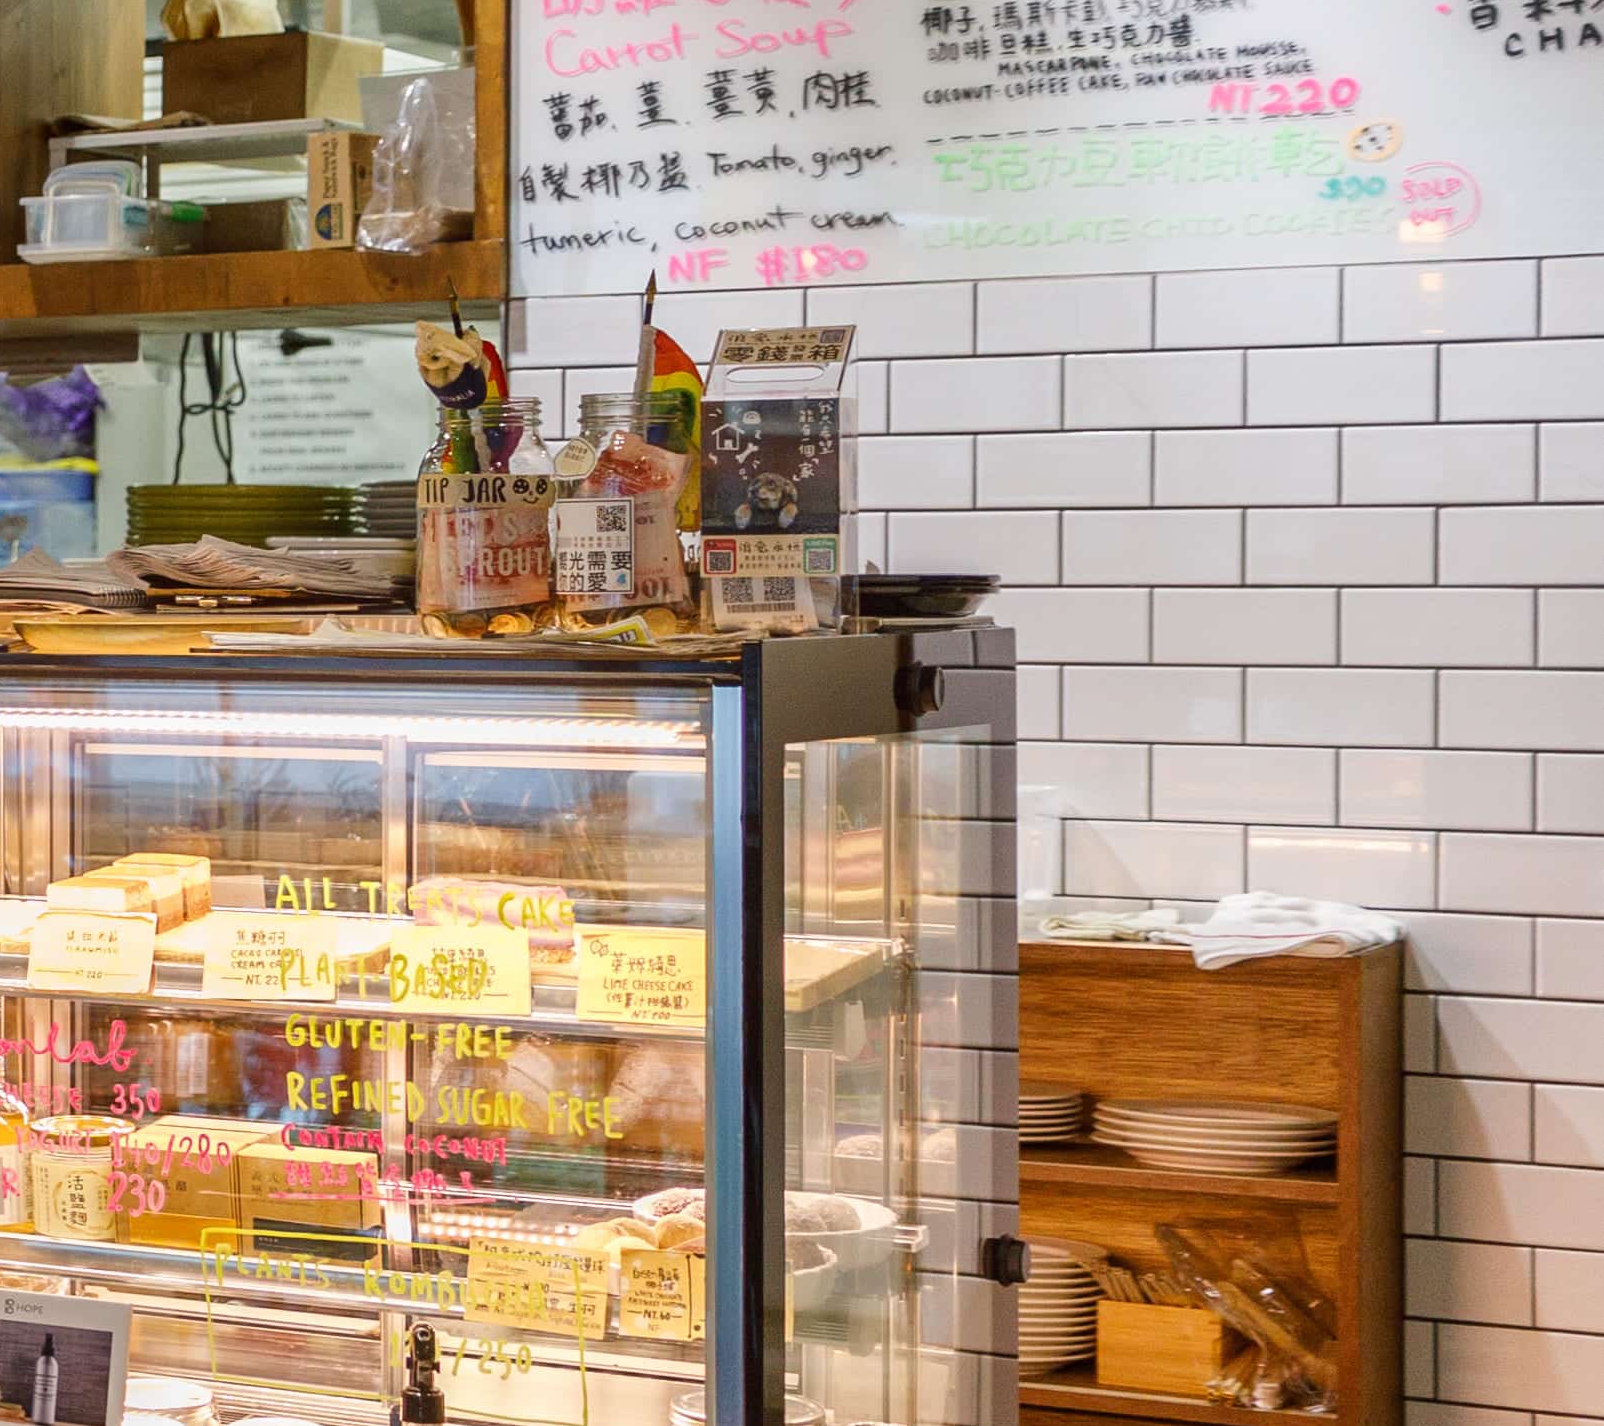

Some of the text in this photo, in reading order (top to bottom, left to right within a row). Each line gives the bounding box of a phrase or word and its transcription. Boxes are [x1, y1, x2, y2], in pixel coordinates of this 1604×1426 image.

[545, 18, 853, 77] Carrot Soup
[675, 205, 803, 241] coconut
[668, 247, 731, 284] NF
[425, 477, 506, 503] TIP JAR
[275, 874, 336, 917] ALL
[498, 891, 576, 931] CAKE
[111, 1082, 161, 1120] 350
[286, 1071, 624, 1140] REFINED SUGAR FREE
[106, 1170, 166, 1218] 230
[216, 1242, 330, 1289] PLANTS
[16, 1304, 44, 1315] HOPE
